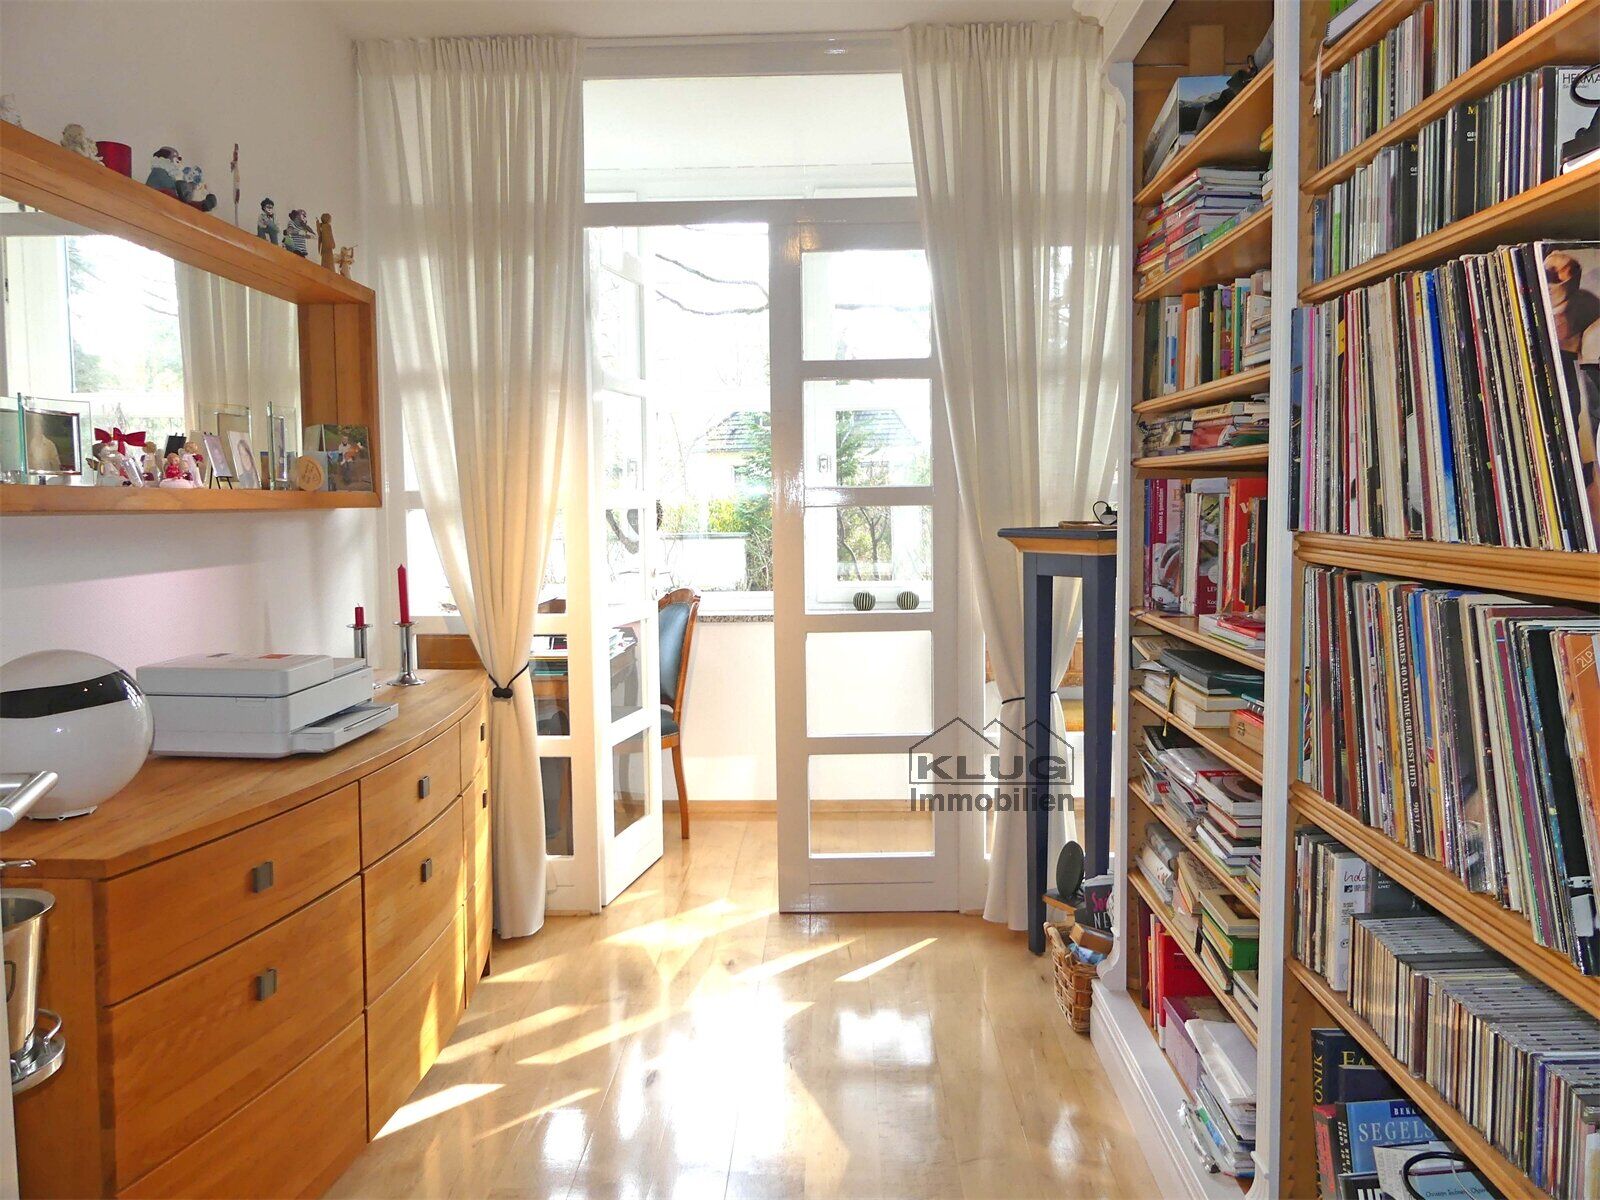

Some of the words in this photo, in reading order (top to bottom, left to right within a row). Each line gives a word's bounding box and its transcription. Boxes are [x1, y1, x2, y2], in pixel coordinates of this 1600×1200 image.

[1397, 624, 1407, 664] CHARLES
[1401, 664, 1408, 676] 40
[1576, 650, 1594, 669] 2LP
[1401, 677, 1410, 694] ALL
[1403, 695, 1412, 718] TIME
[1405, 718, 1415, 765] GREATEST
[1409, 765, 1418, 788] HITS
